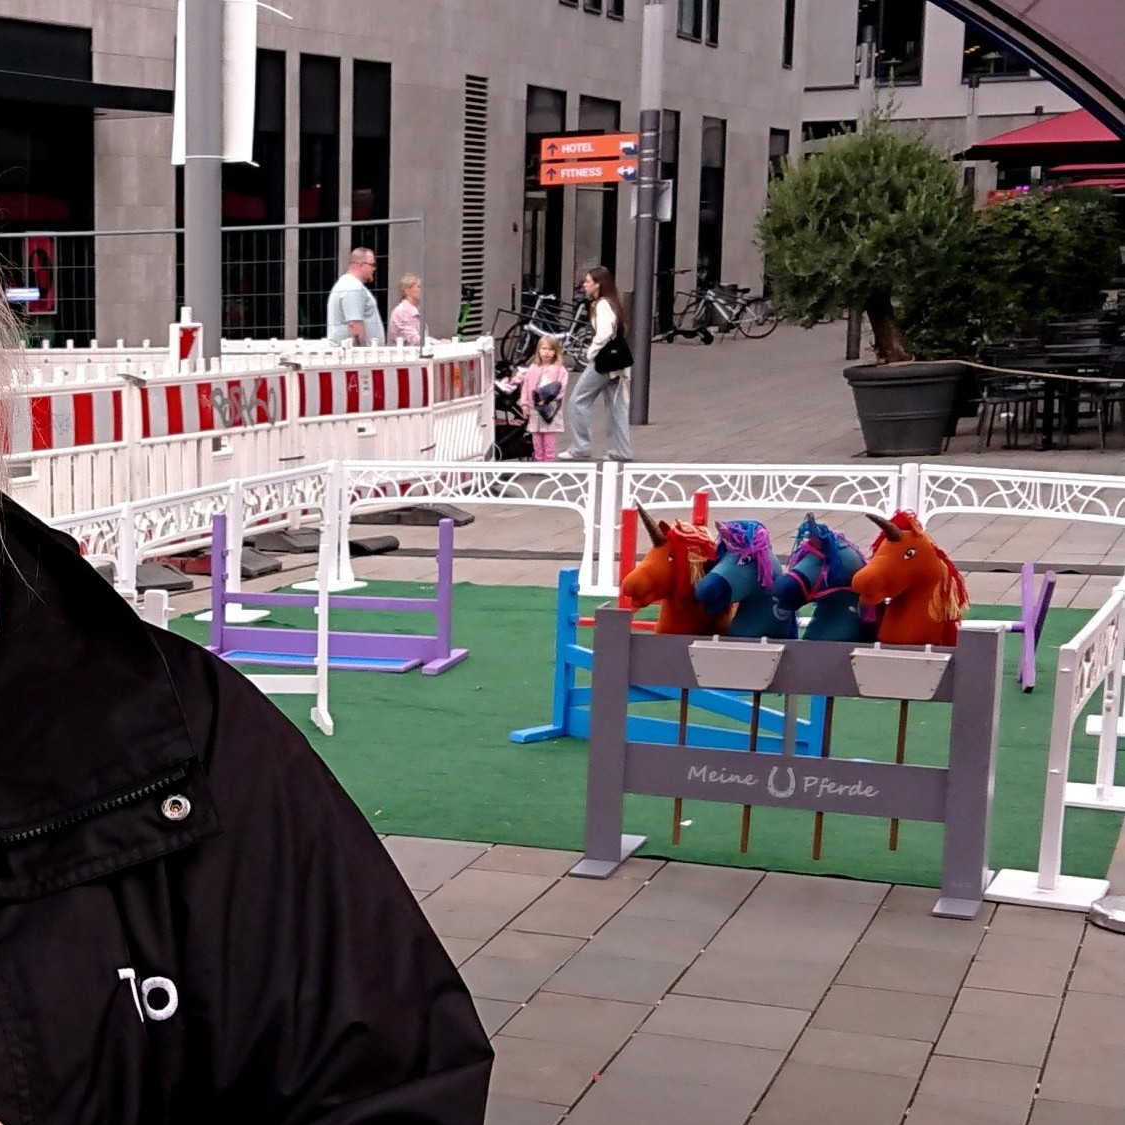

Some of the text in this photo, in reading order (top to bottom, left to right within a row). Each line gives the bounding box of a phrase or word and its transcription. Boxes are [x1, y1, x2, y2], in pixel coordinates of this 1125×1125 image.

[561, 143, 593, 153] HOTEL
[560, 167, 602, 178] FITNESS
[687, 765, 880, 798] Meine Pferde
